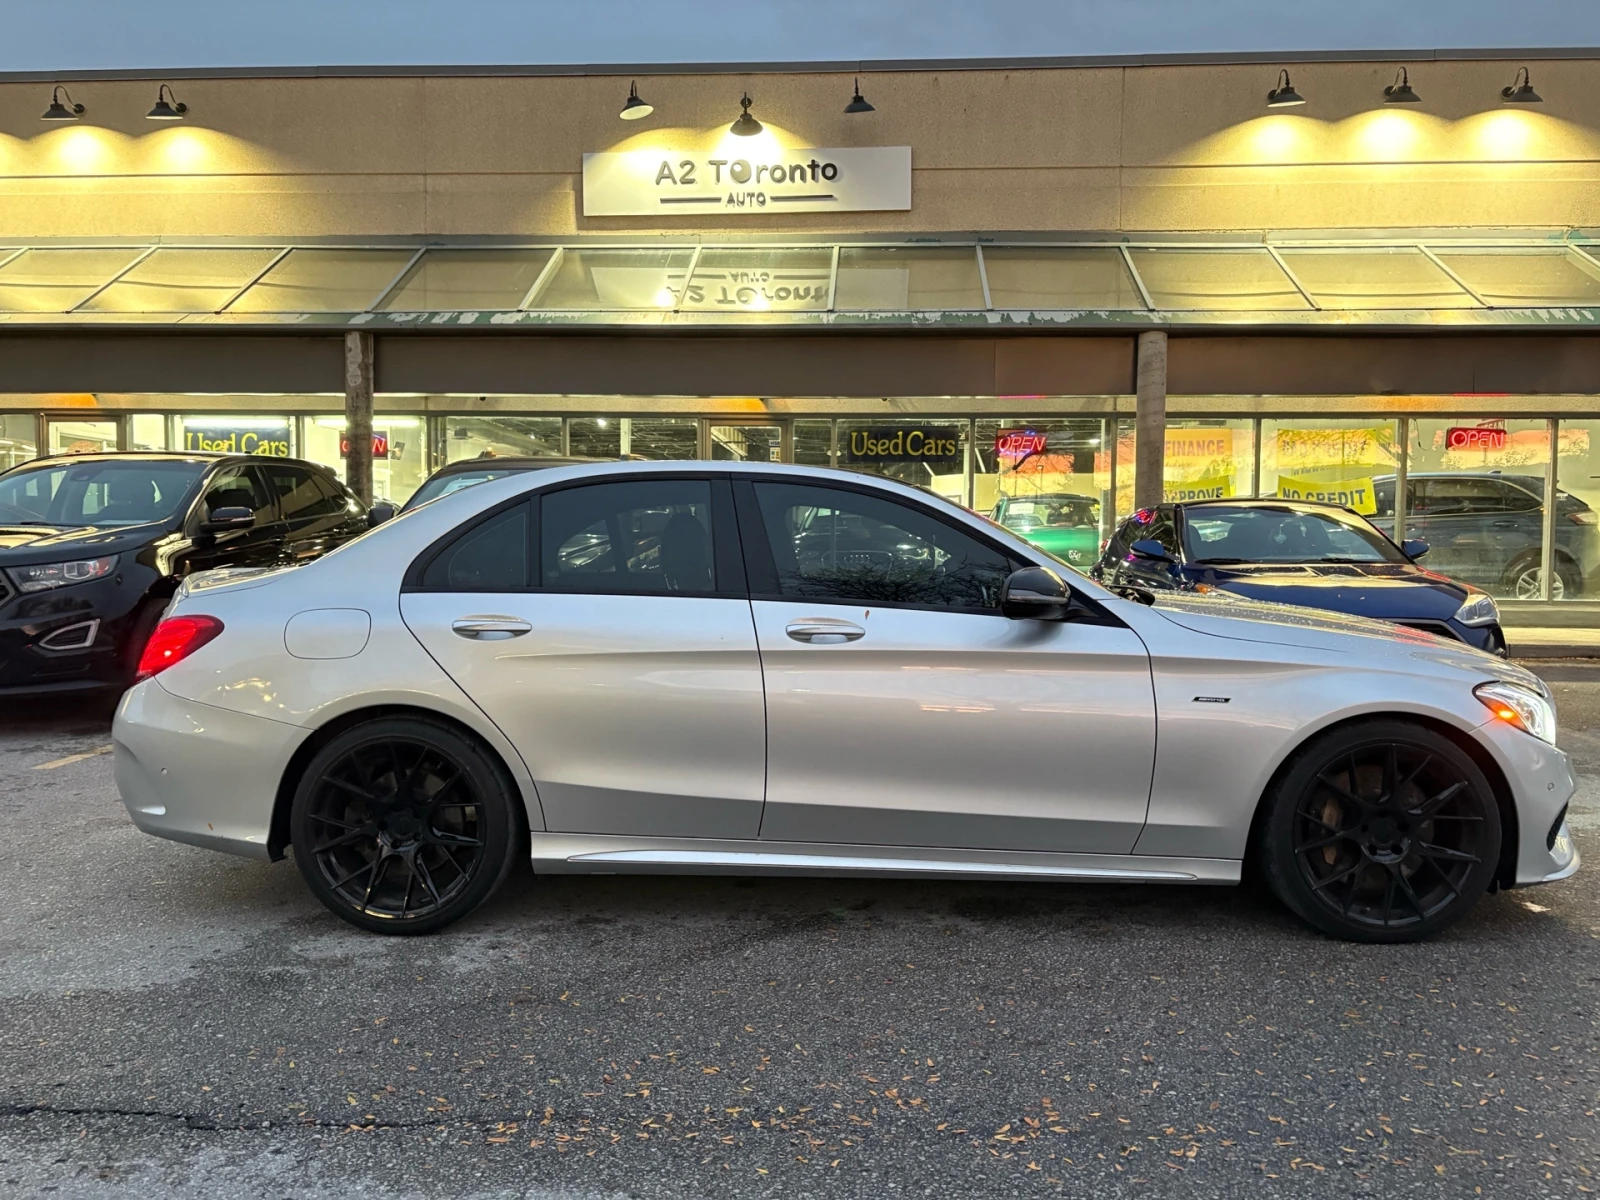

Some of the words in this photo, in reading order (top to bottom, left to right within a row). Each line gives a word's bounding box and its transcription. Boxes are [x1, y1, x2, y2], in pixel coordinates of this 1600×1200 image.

[655, 159, 697, 185] A2
[726, 191, 767, 207] AUTO
[186, 432, 236, 453] Used
[241, 432, 289, 457] Cars
[851, 431, 904, 456] Used
[906, 431, 956, 456] Cars
[998, 436, 1047, 451] OPEN
[1164, 439, 1226, 457] FINANCE
[1451, 431, 1505, 448] OPEN
[1164, 486, 1226, 503] PROVE
[1282, 487, 1301, 499] NO
[1306, 489, 1366, 506] CREDIT
